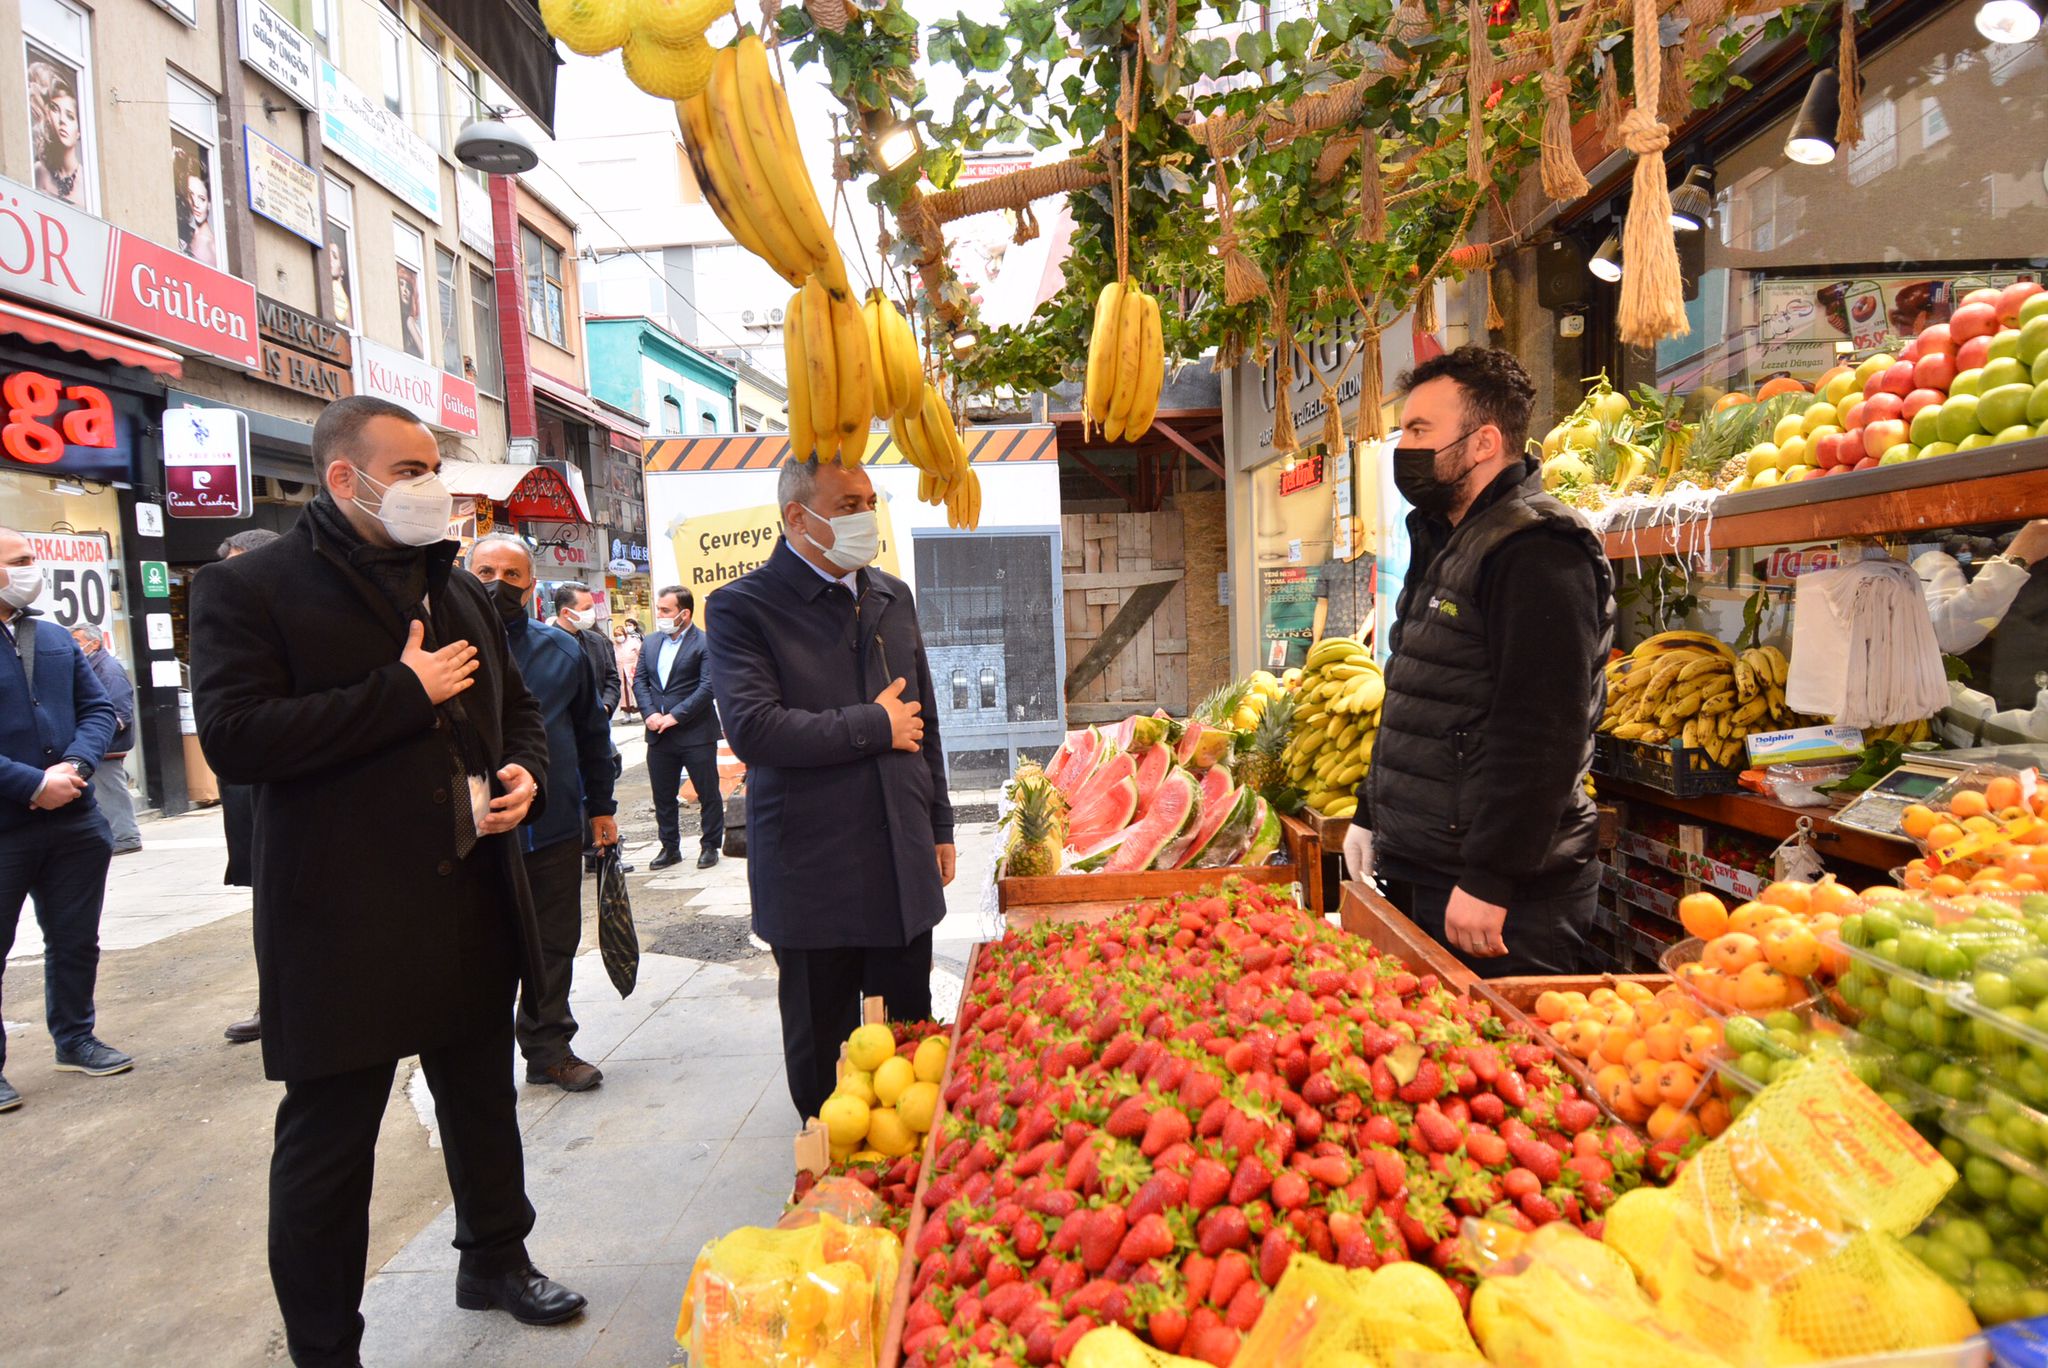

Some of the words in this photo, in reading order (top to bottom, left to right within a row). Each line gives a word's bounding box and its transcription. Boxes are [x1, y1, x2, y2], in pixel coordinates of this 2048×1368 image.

[130, 262, 249, 343] Gülten
[256, 297, 342, 357] MERKEZ
[1761, 360, 1788, 370] Lezzet
[1789, 358, 1824, 369] Dünyası
[367, 359, 436, 409] KUAFÖR
[443, 392, 476, 420] Gülten
[699, 525, 773, 556] Çevreye
[1755, 733, 1795, 744] Dolphin
[1824, 729, 1834, 737] M
[1714, 863, 1740, 882] ÇEVİK
[1732, 881, 1755, 899] GIDA
